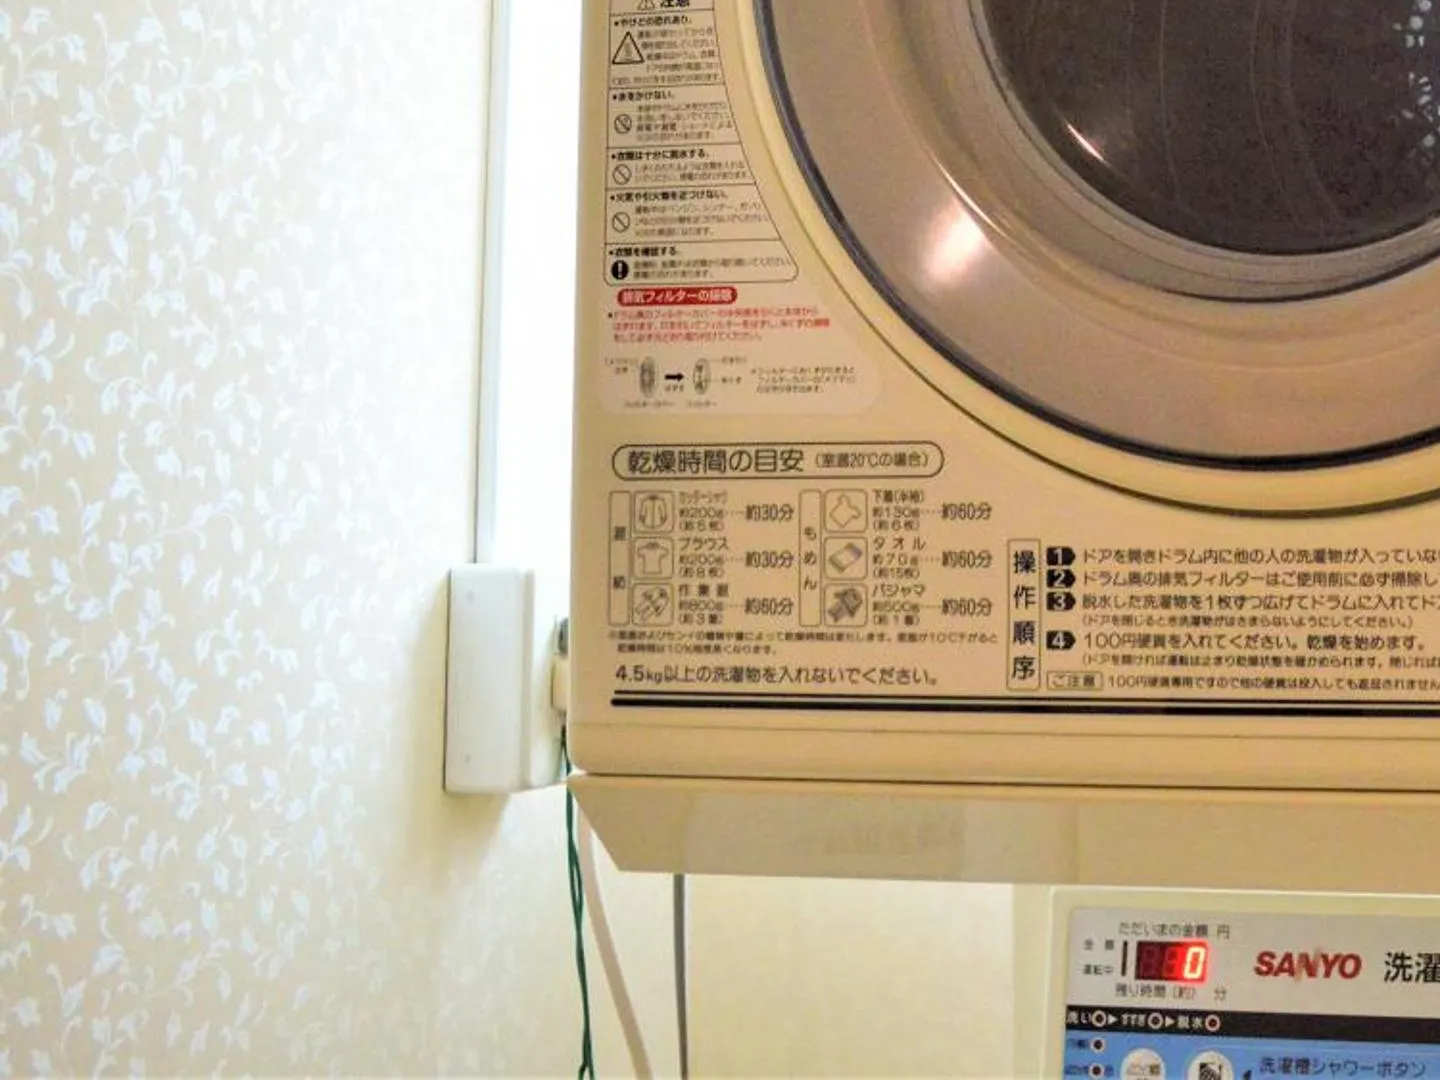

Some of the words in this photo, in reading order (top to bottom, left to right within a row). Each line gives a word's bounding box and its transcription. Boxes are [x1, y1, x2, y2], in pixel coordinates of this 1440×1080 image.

[628, 448, 804, 473] 乾燥時間の目安
[1012, 550, 1036, 681] 操作順序
[615, 664, 938, 686] 4.5kg以上の洗濯物を入れないでください。
[1216, 924, 1230, 940] 円
[1183, 946, 1206, 980] 0
[1254, 947, 1363, 982] SANYO
